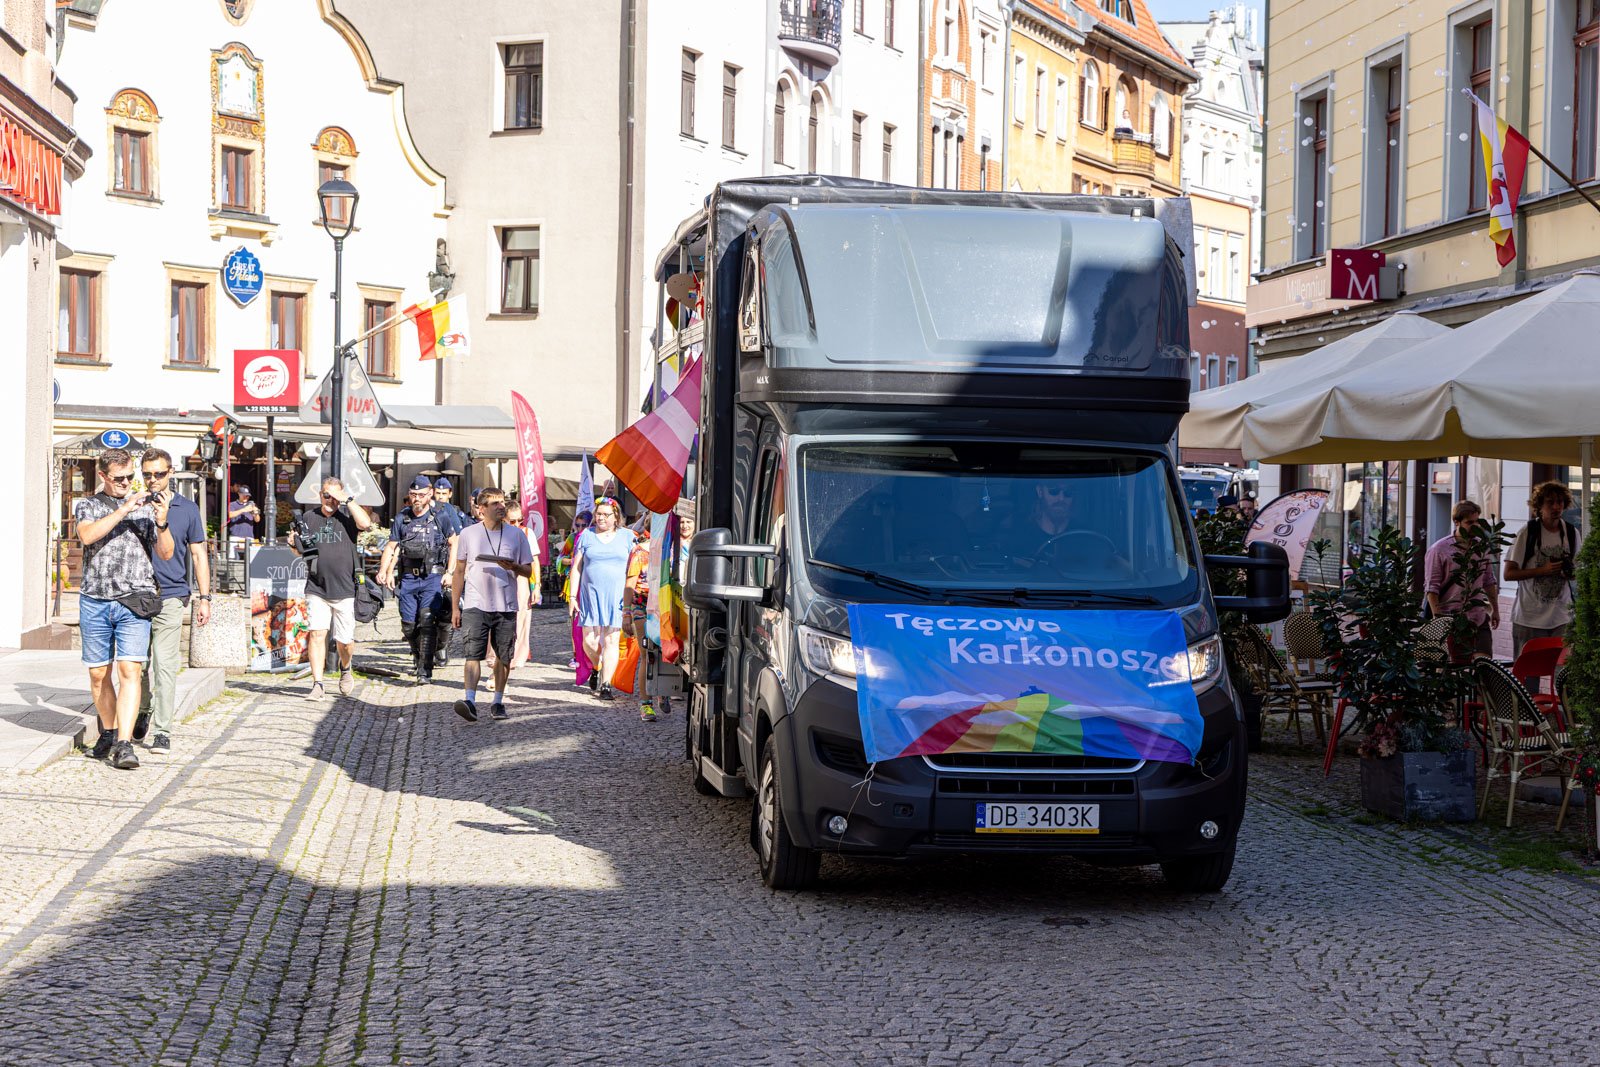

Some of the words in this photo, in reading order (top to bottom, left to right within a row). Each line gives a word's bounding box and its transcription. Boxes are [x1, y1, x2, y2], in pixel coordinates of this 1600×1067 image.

[0, 116, 62, 214] SSMANN
[1286, 276, 1326, 303] Millenniu
[1347, 267, 1378, 300] M
[1102, 355, 1129, 363] Carpol
[253, 374, 278, 385] Pizza
[257, 381, 274, 391] Hut
[948, 637, 1189, 680] Karkonosze
[991, 805, 1018, 827] DB
[1027, 806, 1093, 827] 3403K
